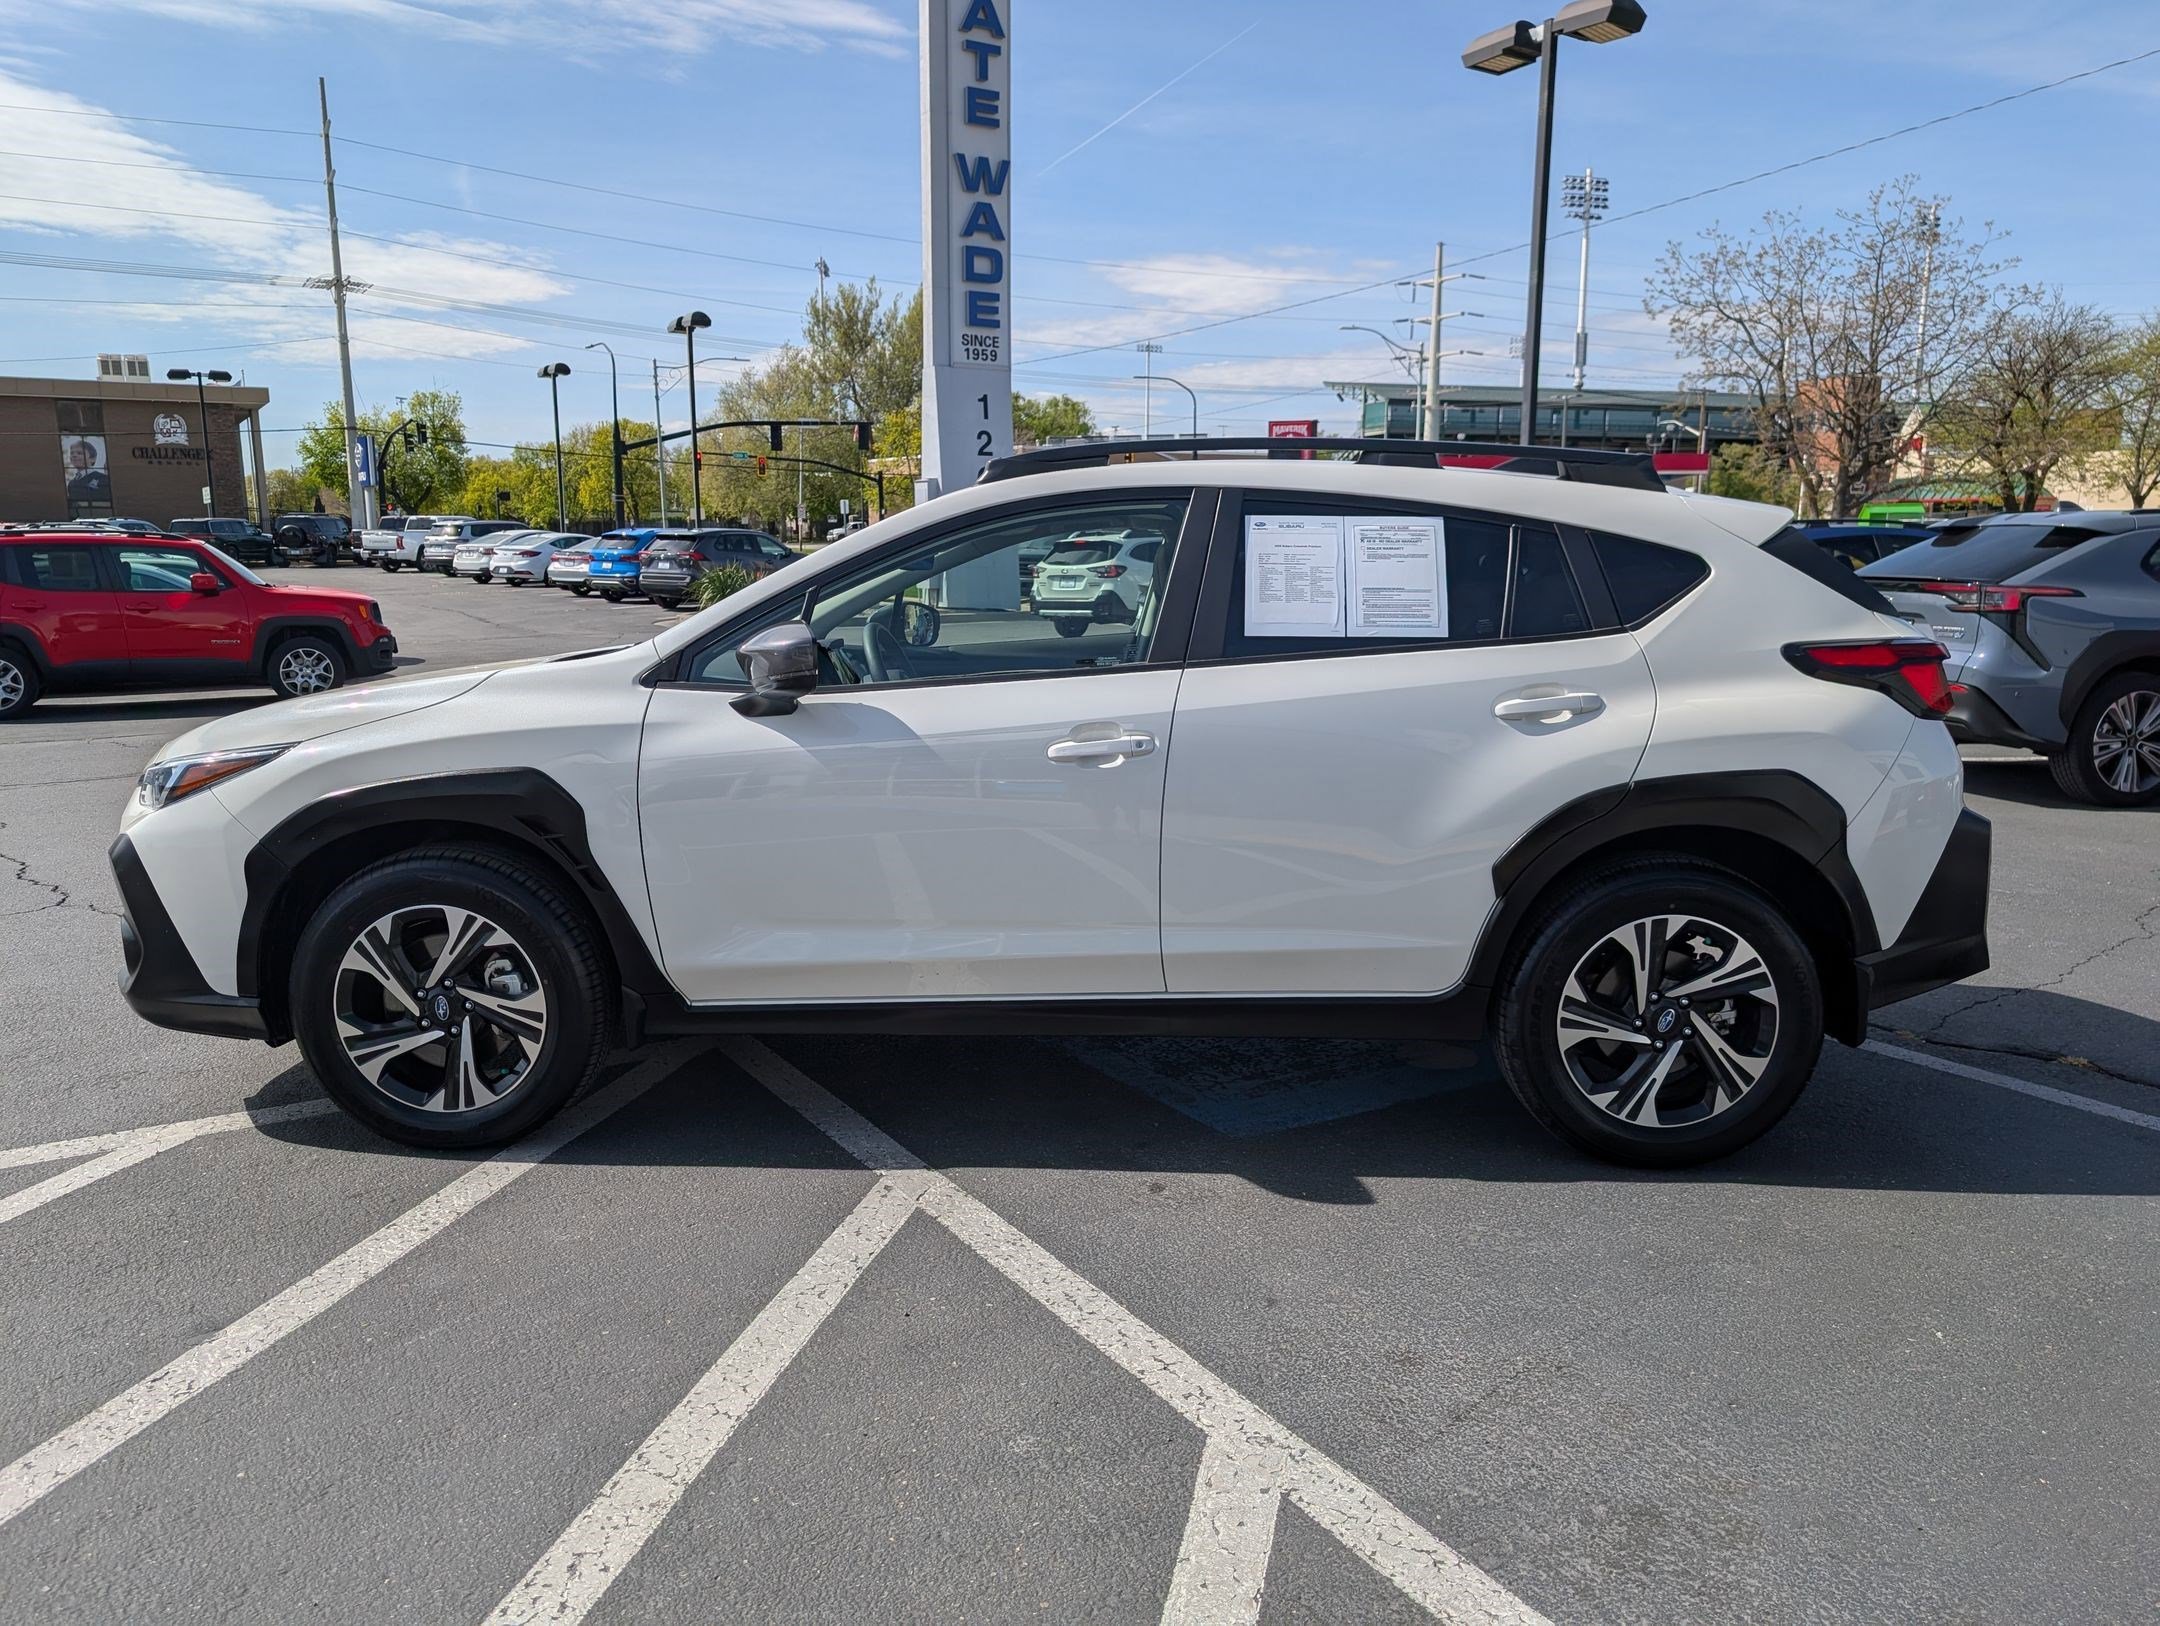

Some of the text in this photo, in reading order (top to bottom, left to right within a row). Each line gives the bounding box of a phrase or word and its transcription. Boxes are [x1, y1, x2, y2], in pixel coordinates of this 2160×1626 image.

[953, 152, 1010, 329] WADE
[961, 333, 999, 348] SINCE
[964, 348, 998, 362] 1959
